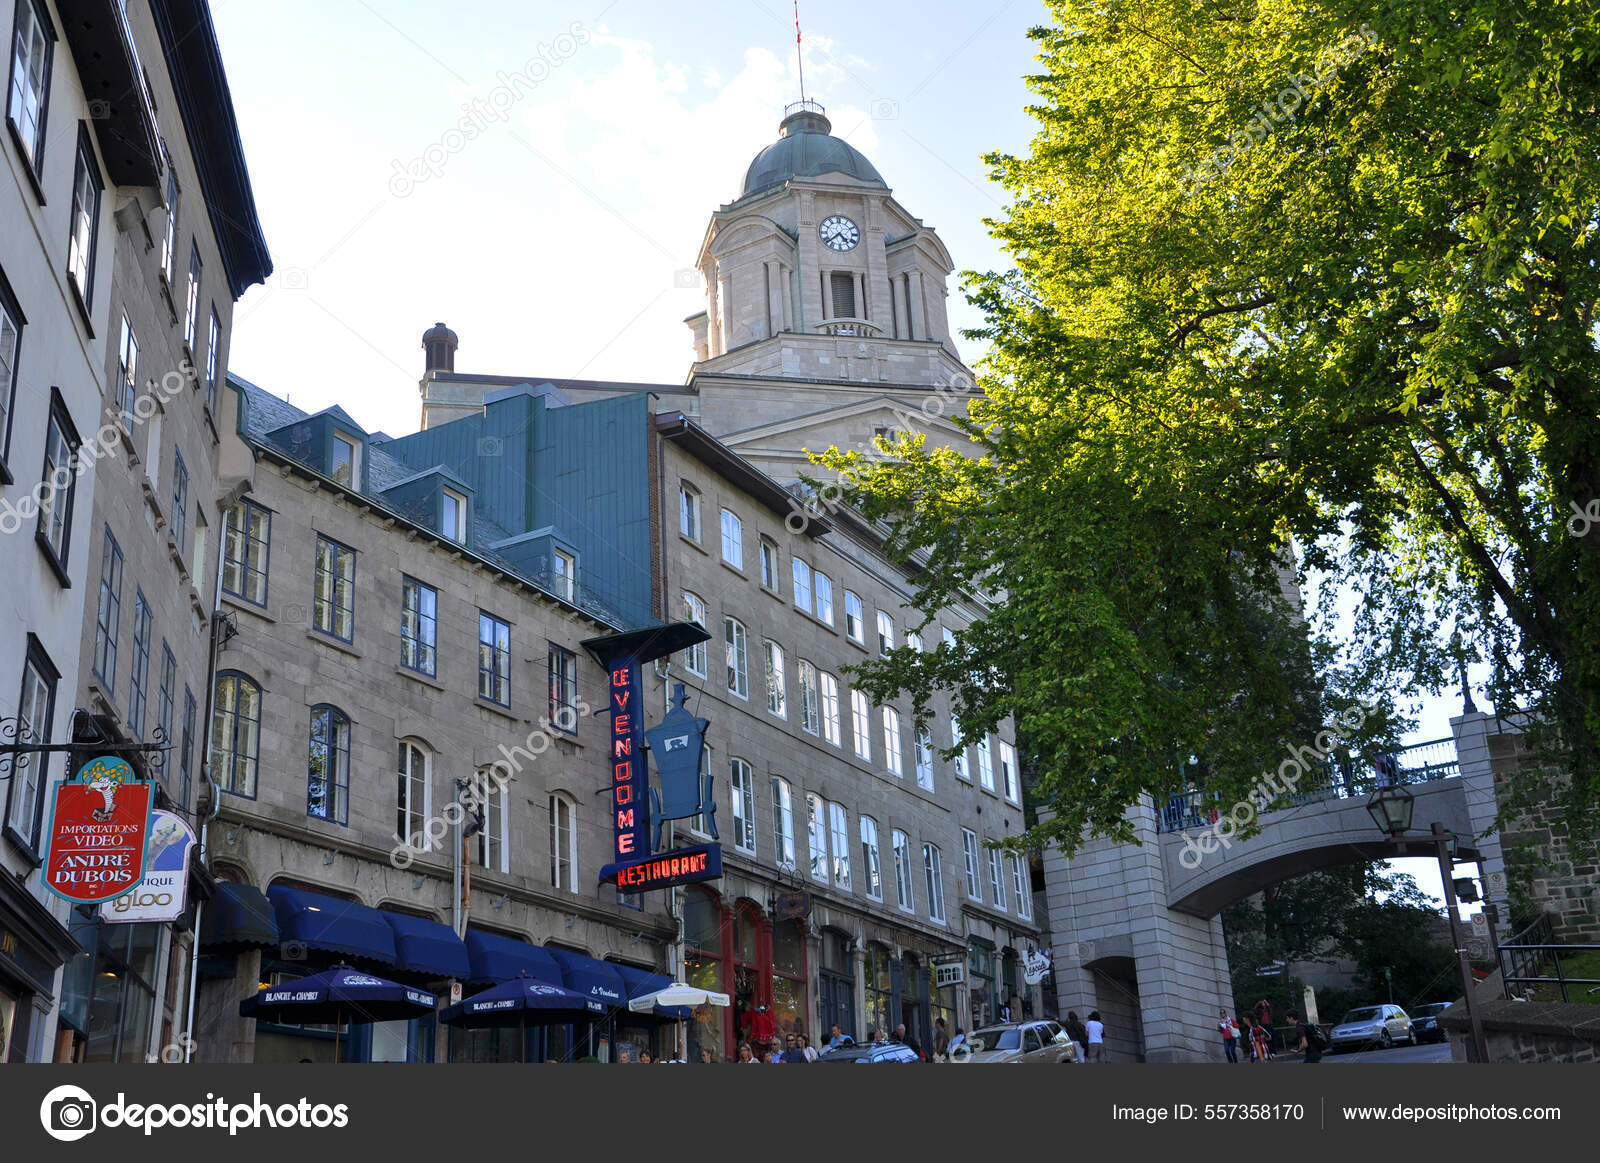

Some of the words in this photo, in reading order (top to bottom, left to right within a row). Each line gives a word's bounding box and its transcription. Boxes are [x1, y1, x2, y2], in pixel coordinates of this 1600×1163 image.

[60, 824, 138, 834] IMPORTATIONS
[74, 835, 124, 847] VIDEO
[60, 852, 131, 868] ANDRÉ
[54, 869, 132, 883] DUBOIS
[617, 852, 707, 889] RESTAURANT
